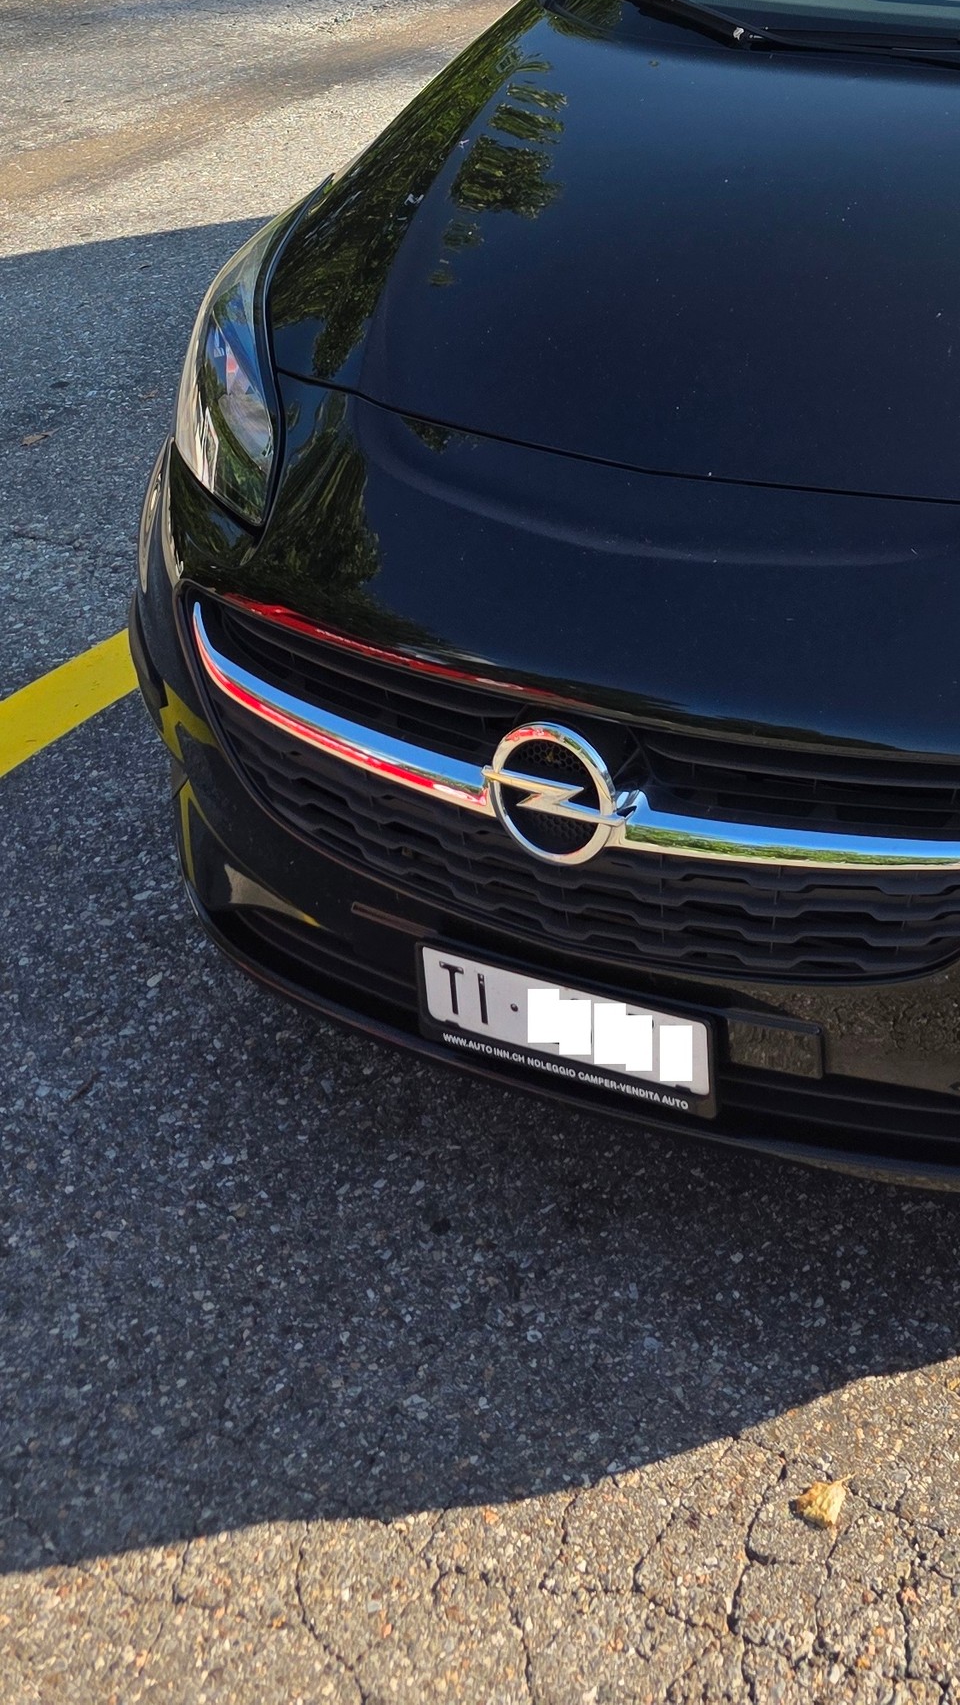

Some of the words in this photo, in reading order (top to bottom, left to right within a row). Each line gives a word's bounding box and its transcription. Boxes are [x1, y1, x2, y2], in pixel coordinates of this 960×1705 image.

[438, 961, 489, 1026] TI
[527, 1057, 576, 1077] NOLEGGIO
[662, 1095, 689, 1110] AUTO
